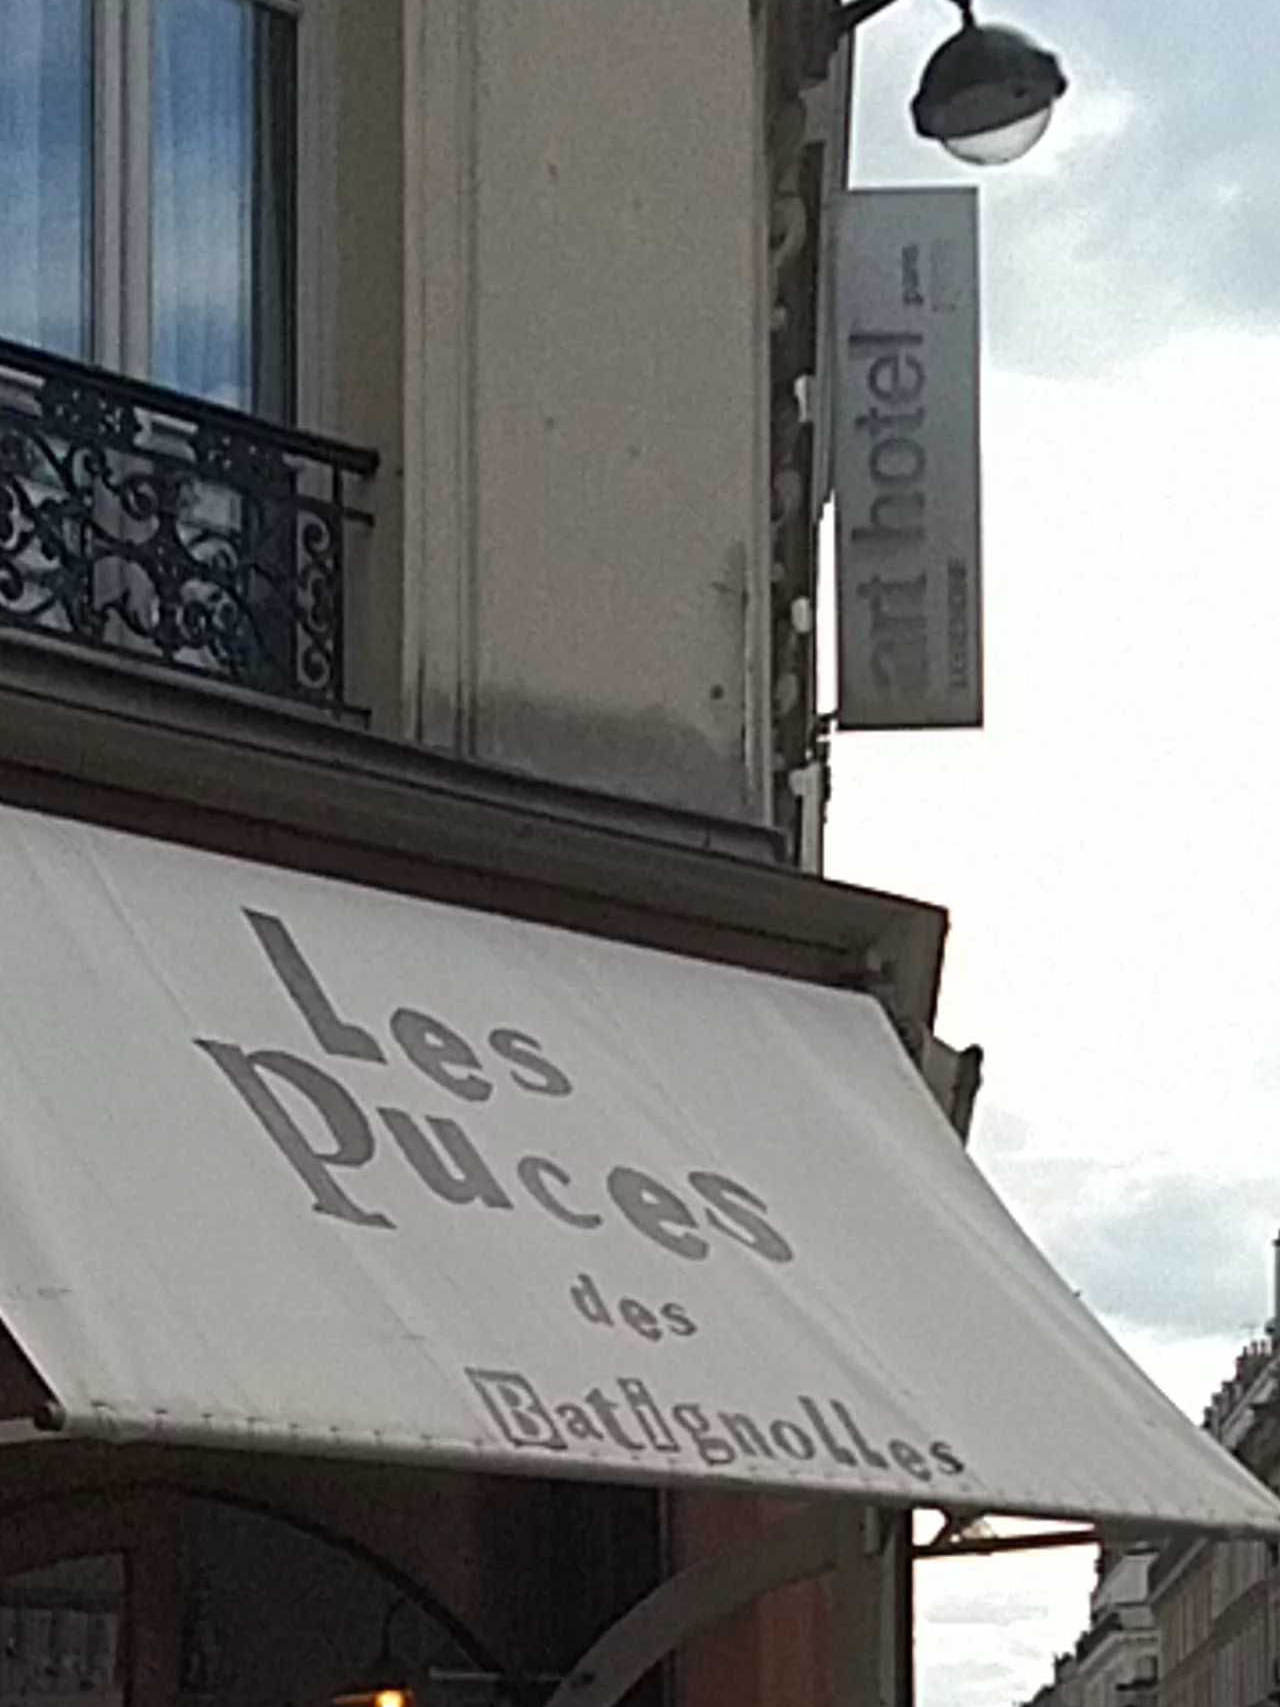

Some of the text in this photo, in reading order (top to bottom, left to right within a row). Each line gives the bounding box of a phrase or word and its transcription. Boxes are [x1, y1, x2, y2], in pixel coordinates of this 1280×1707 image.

[848, 331, 927, 692] art hotel
[240, 906, 574, 1103] Les
[568, 1272, 699, 1341] des
[463, 1367, 965, 1482] Batignolles
